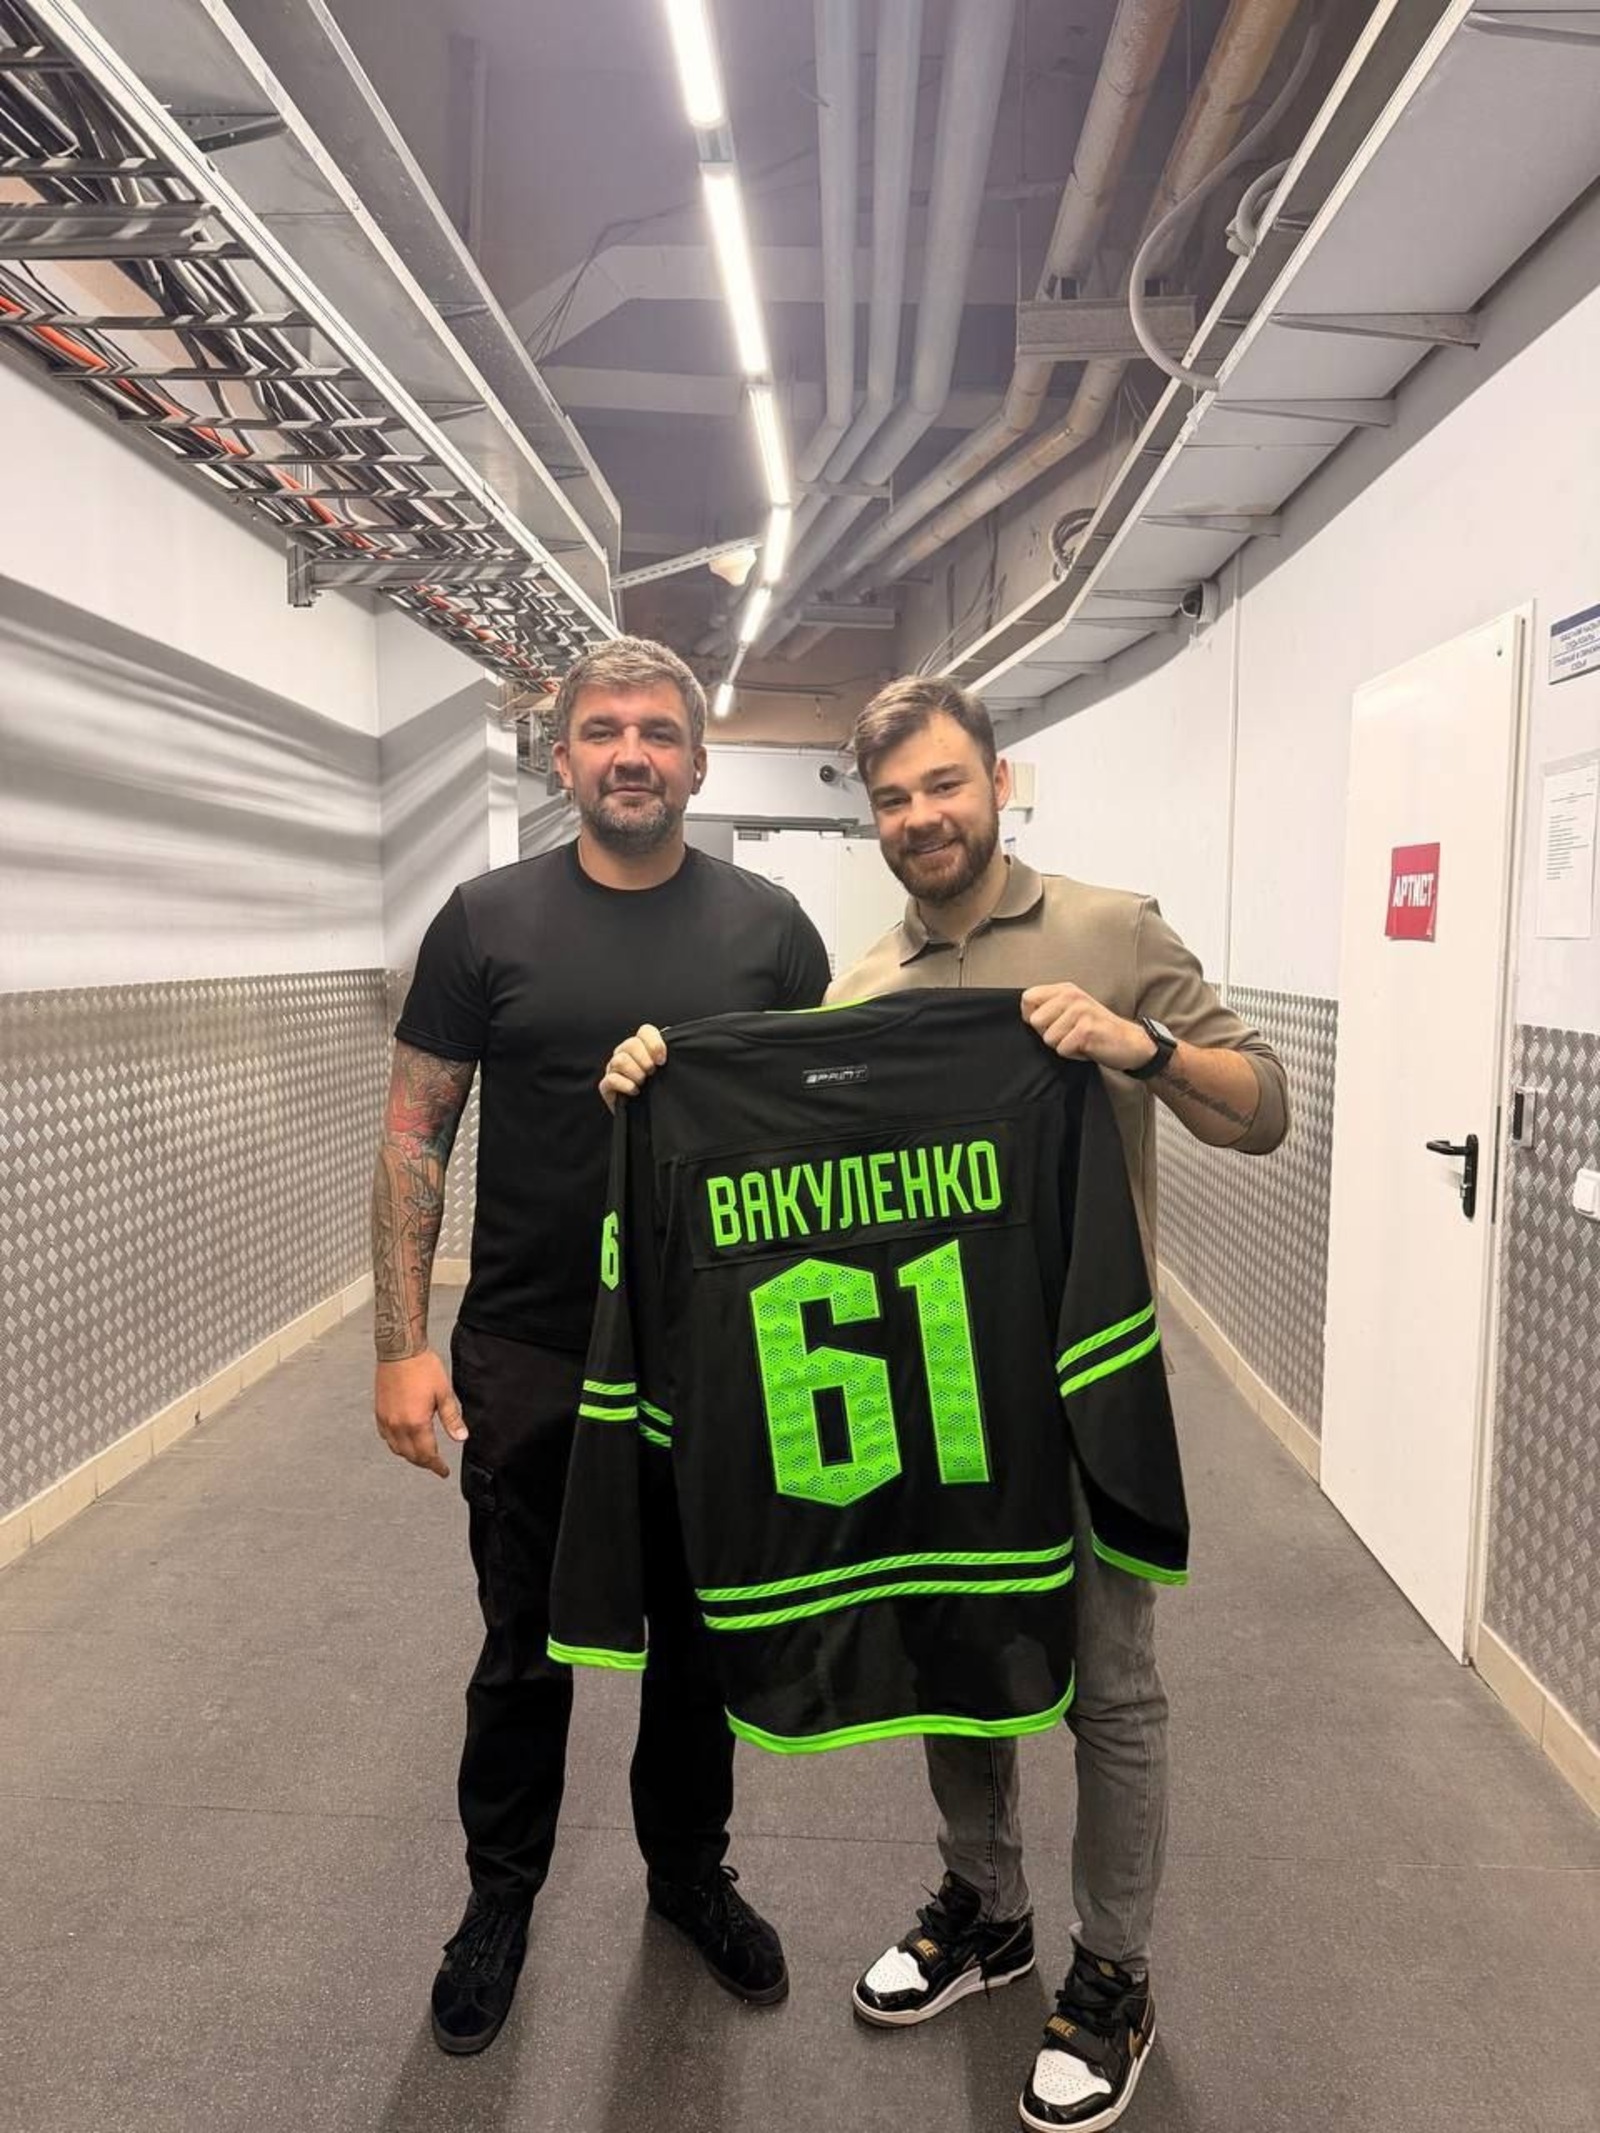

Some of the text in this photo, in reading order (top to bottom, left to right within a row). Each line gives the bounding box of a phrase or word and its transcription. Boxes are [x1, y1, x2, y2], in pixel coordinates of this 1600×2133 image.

[1393, 872, 1435, 907] АРТИСТ
[707, 1140, 1001, 1247] ВАКУЛЕНКО
[750, 1239, 990, 1507] 61
